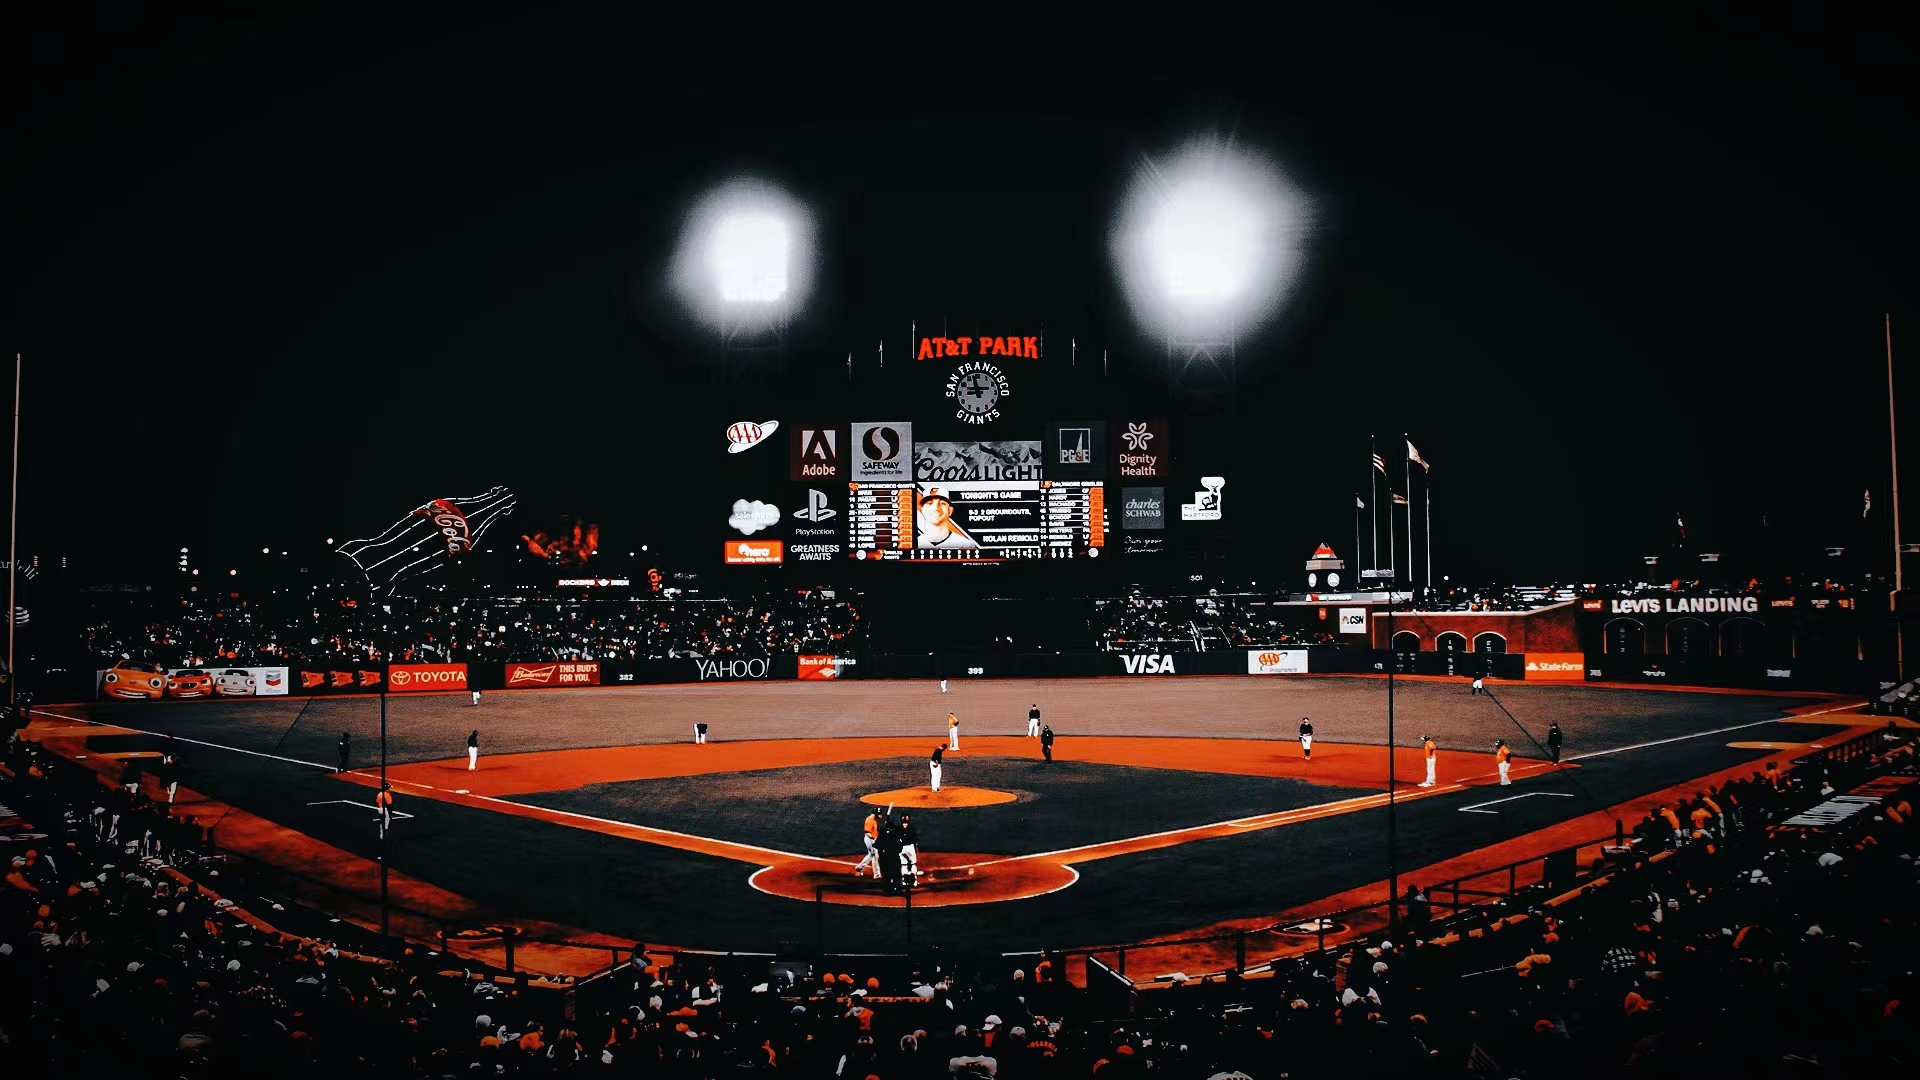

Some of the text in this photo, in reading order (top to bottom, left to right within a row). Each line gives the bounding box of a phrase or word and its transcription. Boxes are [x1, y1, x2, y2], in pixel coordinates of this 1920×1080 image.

[918, 337, 1038, 360] AT&T PARK
[946, 362, 1010, 397] SAN FRANCISCO
[956, 409, 1001, 424] GIANTS
[1061, 450, 1089, 462] PG&E
[1119, 454, 1157, 466] Dignity
[802, 463, 836, 475] Adobe
[915, 458, 1042, 481] Coors LIGHT
[1121, 466, 1156, 476] Health
[1126, 499, 1160, 509] charles
[790, 544, 839, 553] GREATNESS
[1666, 597, 1758, 613] LANDING
[1350, 616, 1364, 624] CSN
[800, 657, 856, 665] Bank of America
[1119, 654, 1175, 673] VISA
[1539, 662, 1583, 671] State Farm
[577, 664, 597, 672] BUD'S
[696, 658, 770, 680] YAHOO!
[413, 671, 467, 683] TOYOTA
[513, 671, 551, 679] Budweiser
[560, 674, 590, 682] FOR YOU.
